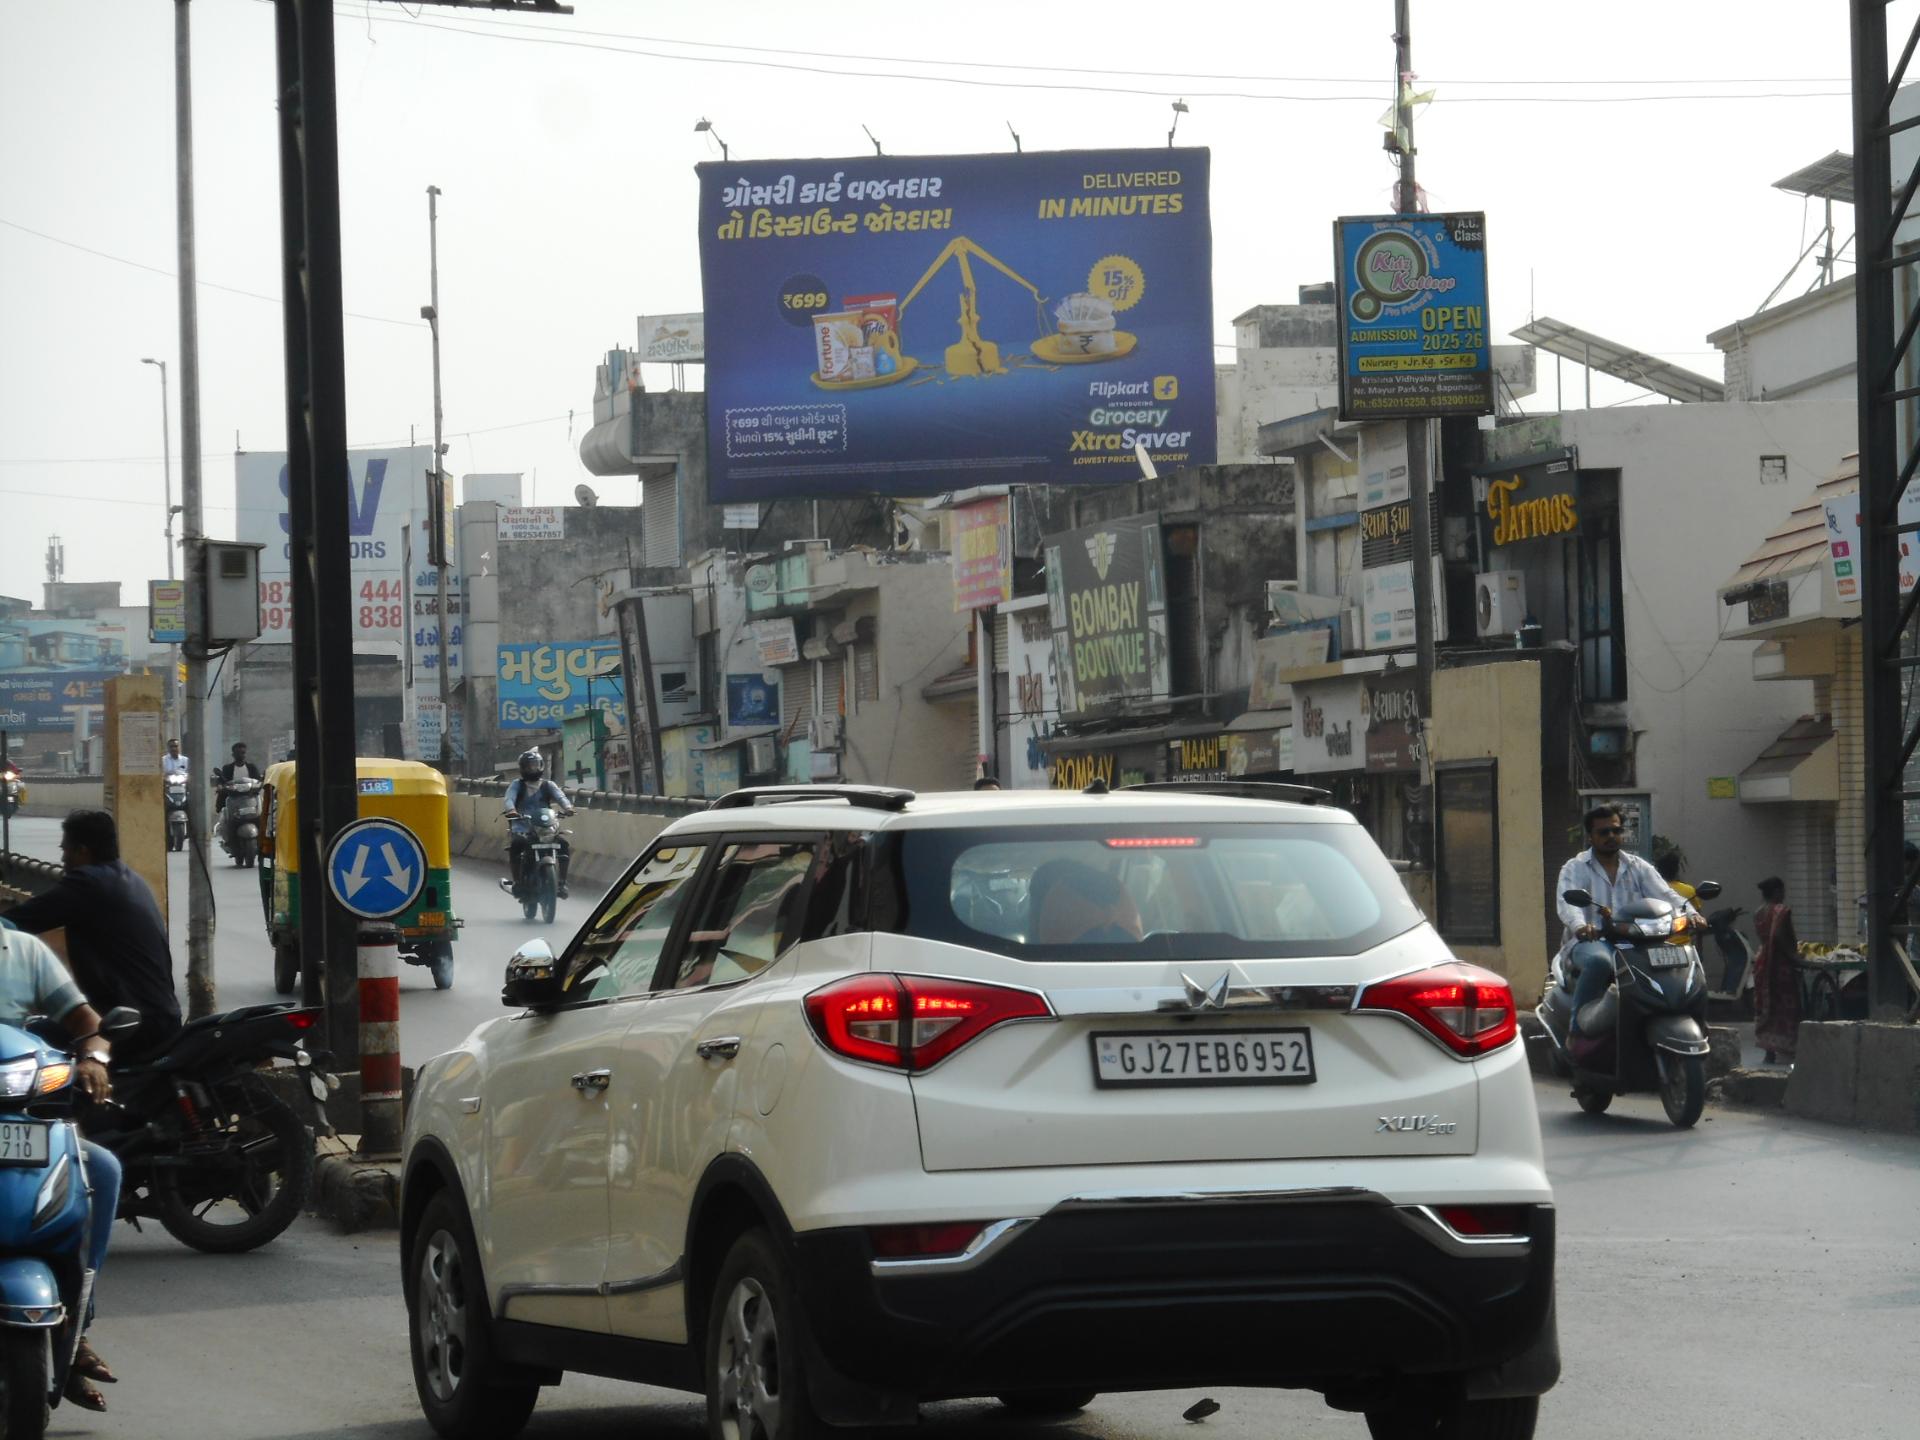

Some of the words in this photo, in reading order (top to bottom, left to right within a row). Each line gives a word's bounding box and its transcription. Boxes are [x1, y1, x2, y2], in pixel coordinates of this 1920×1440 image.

[722, 174, 795, 207] ગ્રોસરી
[800, 171, 845, 203] કાર્ટ
[847, 176, 942, 201] વજનદાર
[1083, 171, 1181, 189] DELIVERED
[1039, 198, 1066, 219] IN
[1069, 193, 1183, 217] MINUTES
[717, 210, 744, 240] તો
[749, 207, 858, 239] ડિસ્કાઉન્ટ
[864, 202, 953, 232] જોરદાર!
[783, 292, 827, 309] ₹699
[1422, 306, 1482, 331] OPEN
[1351, 330, 1418, 343] ADMISSION
[1089, 381, 1150, 399] Flipkart
[1090, 408, 1169, 428] Grocery
[1069, 428, 1192, 452] XtraSaver
[1073, 456, 1107, 465] LOWEST
[1071, 581, 1140, 638] BOMBAY
[1074, 632, 1146, 682] BOUTIQUE
[1181, 736, 1220, 770] MAAHI
[1056, 754, 1114, 791] BOMBAY
[1119, 1041, 1307, 1074] GJ27EB6952
